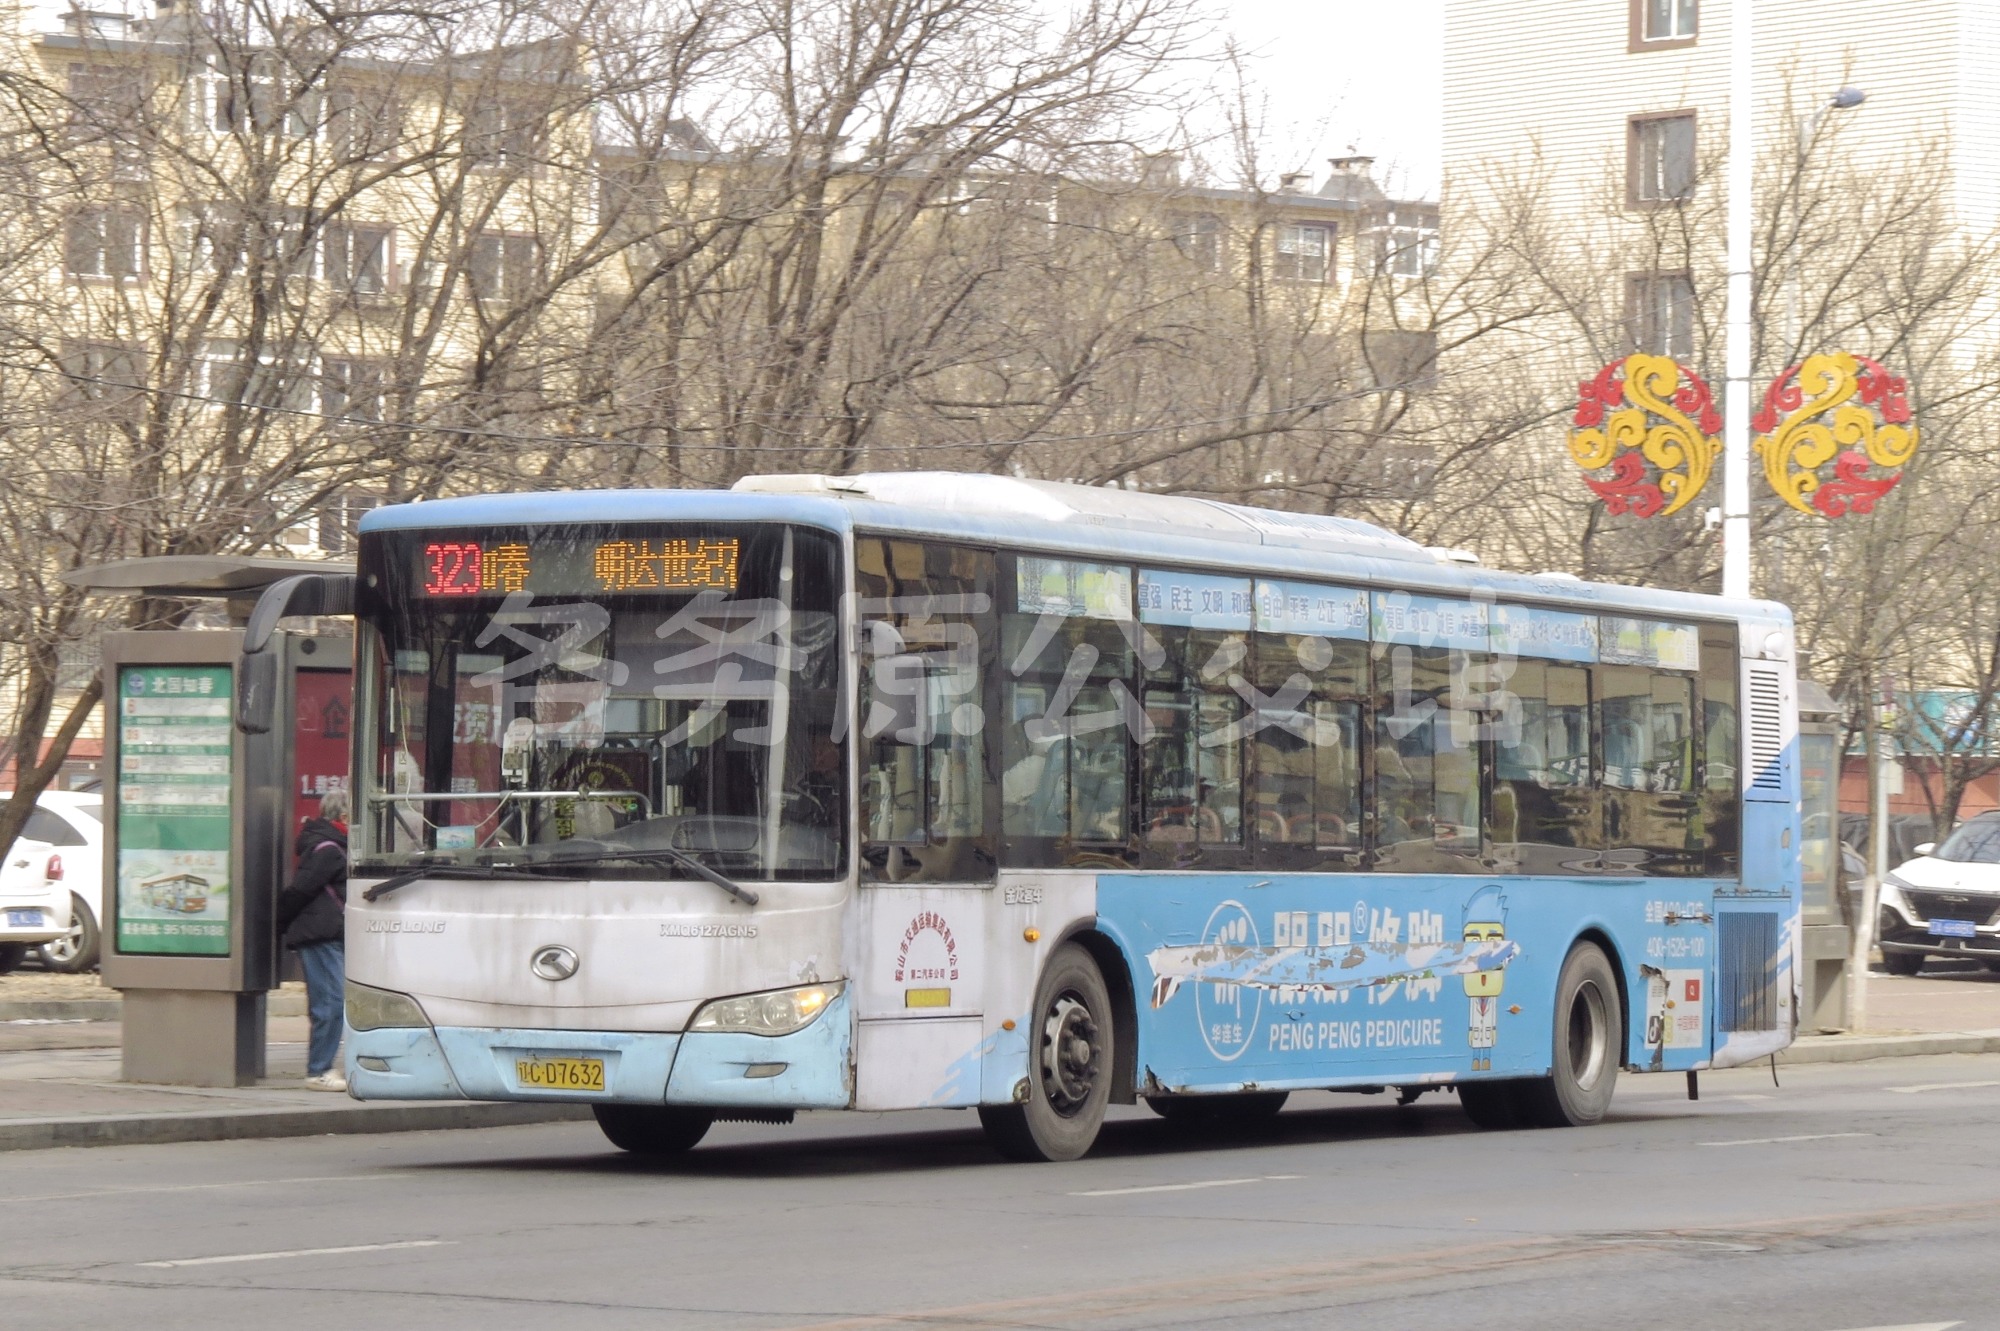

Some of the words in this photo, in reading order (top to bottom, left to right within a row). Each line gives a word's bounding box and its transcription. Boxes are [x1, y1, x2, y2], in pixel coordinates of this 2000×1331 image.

[425, 543, 481, 594] 323
[1138, 583, 1162, 610] 富强
[1170, 586, 1193, 613] 民主
[1201, 589, 1223, 614] 文明
[1262, 593, 1282, 619] 自由
[1290, 597, 1309, 621] 平等
[1317, 599, 1336, 624] 公正
[1385, 606, 1405, 632] 爱国
[365, 919, 402, 933] KING
[403, 920, 446, 934] LONG
[659, 923, 758, 938] XMQ6127AGN5
[911, 969, 945, 980] 第二汽车公司
[1211, 1023, 1243, 1044] 华连生
[1269, 1022, 1314, 1051] PENG
[1318, 1021, 1361, 1049] PENG
[1366, 1018, 1443, 1048] PEDICURE
